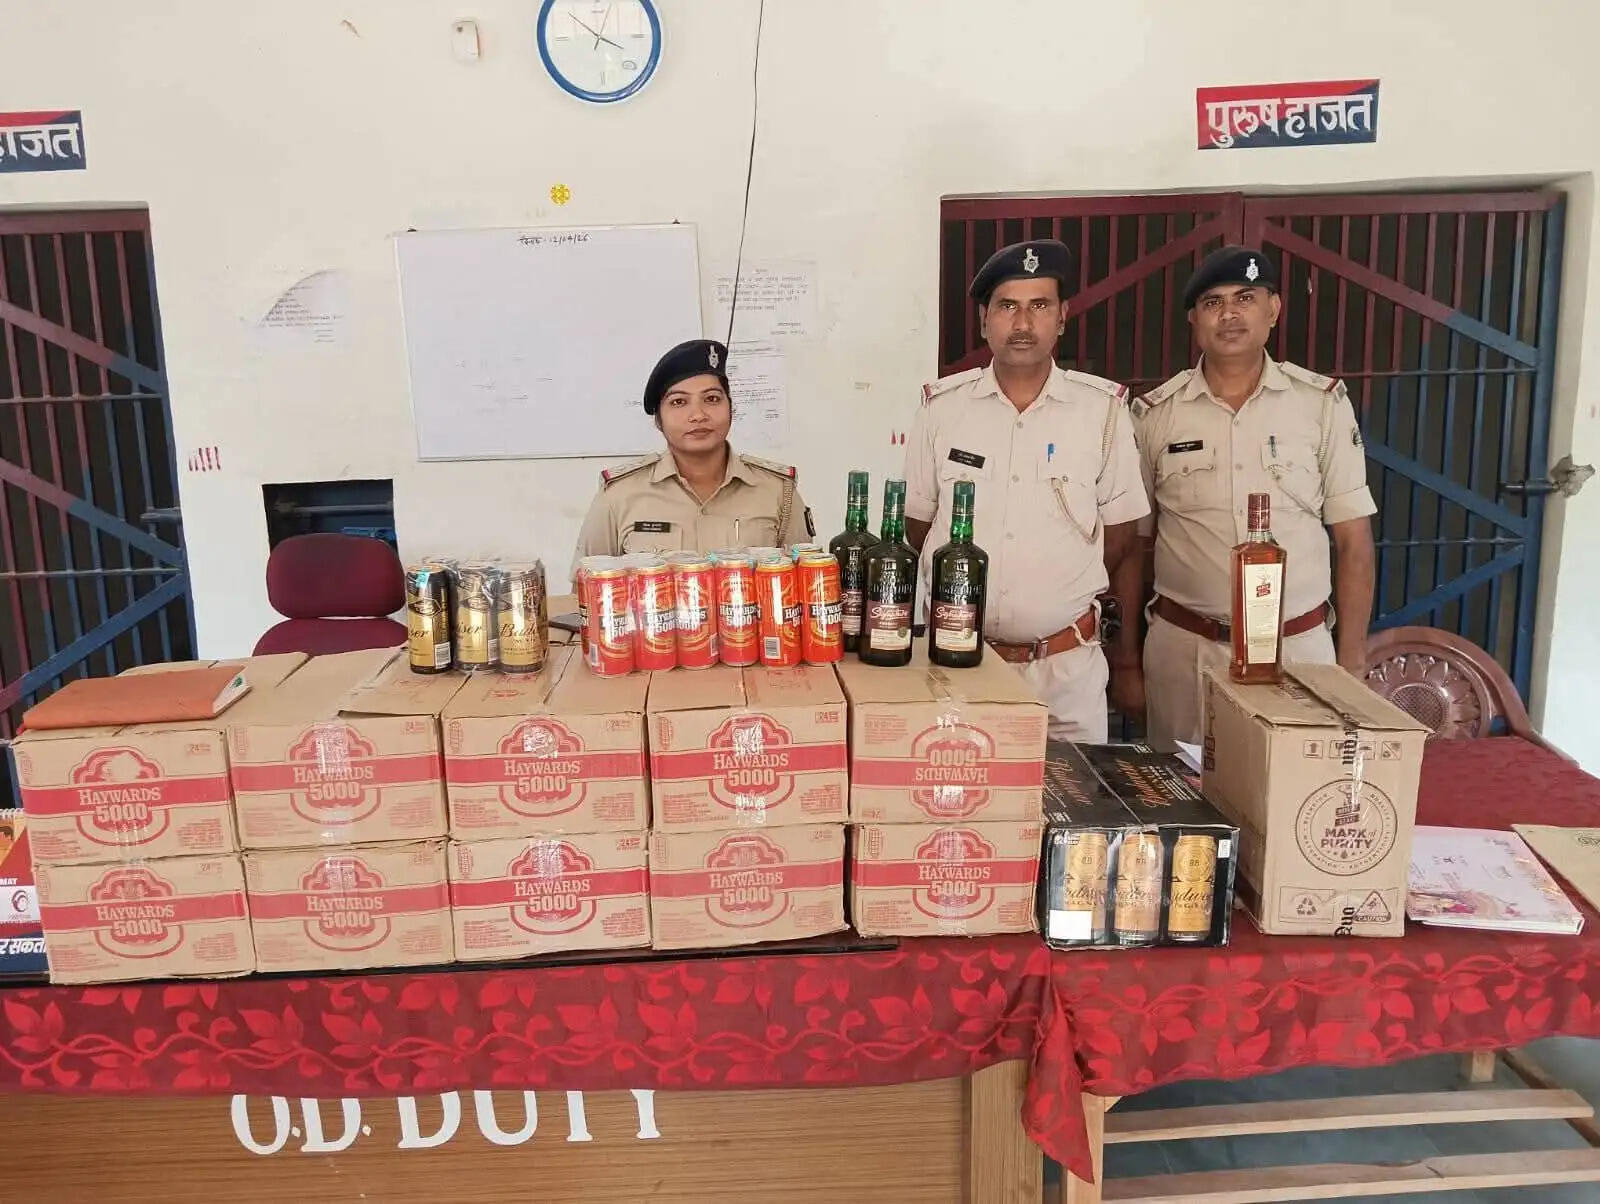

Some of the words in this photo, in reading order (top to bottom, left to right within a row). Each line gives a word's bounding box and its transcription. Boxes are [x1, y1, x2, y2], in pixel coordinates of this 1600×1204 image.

[713, 752, 789, 770] HAYWARDS
[930, 749, 976, 767] 5000
[293, 766, 374, 784] HAYWARDS
[503, 759, 581, 776] HAYWARDS
[915, 767, 989, 784] HAYWARDS
[519, 775, 567, 793] 5000
[728, 768, 776, 786] 5000
[79, 786, 161, 806] HAYWARDS
[309, 781, 360, 800] 5000
[97, 803, 149, 822] 5000
[1325, 828, 1367, 838] MARK
[1320, 838, 1373, 849] PURITY
[709, 871, 784, 889] HAYWARDS
[918, 864, 991, 881] HAYWARDS
[513, 879, 591, 897] HAYWARDS
[723, 886, 772, 905] 5000
[931, 880, 977, 897] 5000
[306, 895, 384, 912] HAYWARDS
[529, 894, 577, 912] 5000
[95, 904, 175, 921] HAYWARDS
[322, 910, 371, 929] 5000
[113, 919, 163, 937] 5000
